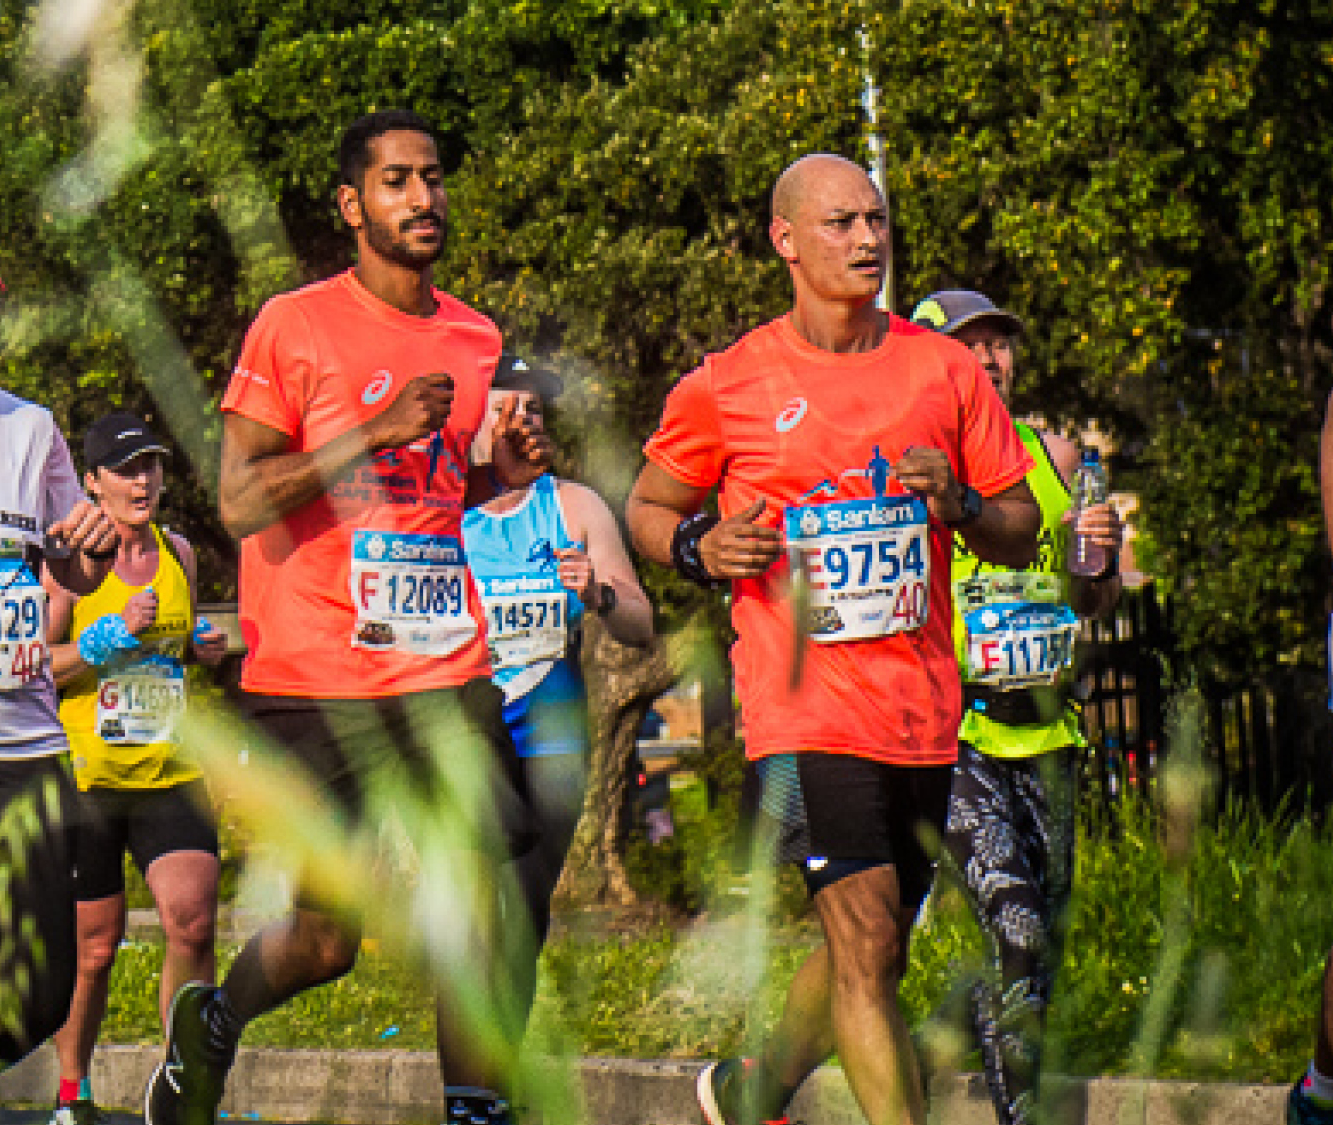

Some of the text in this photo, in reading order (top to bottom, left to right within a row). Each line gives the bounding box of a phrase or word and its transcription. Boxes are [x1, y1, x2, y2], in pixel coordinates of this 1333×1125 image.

[826, 503, 915, 532] Sanlam
[390, 540, 459, 562] Sanlam
[807, 535, 926, 591] E9754
[358, 571, 463, 617] F12089
[893, 582, 929, 627] 40
[491, 600, 561, 634] 14571
[12, 641, 44, 683] 40
